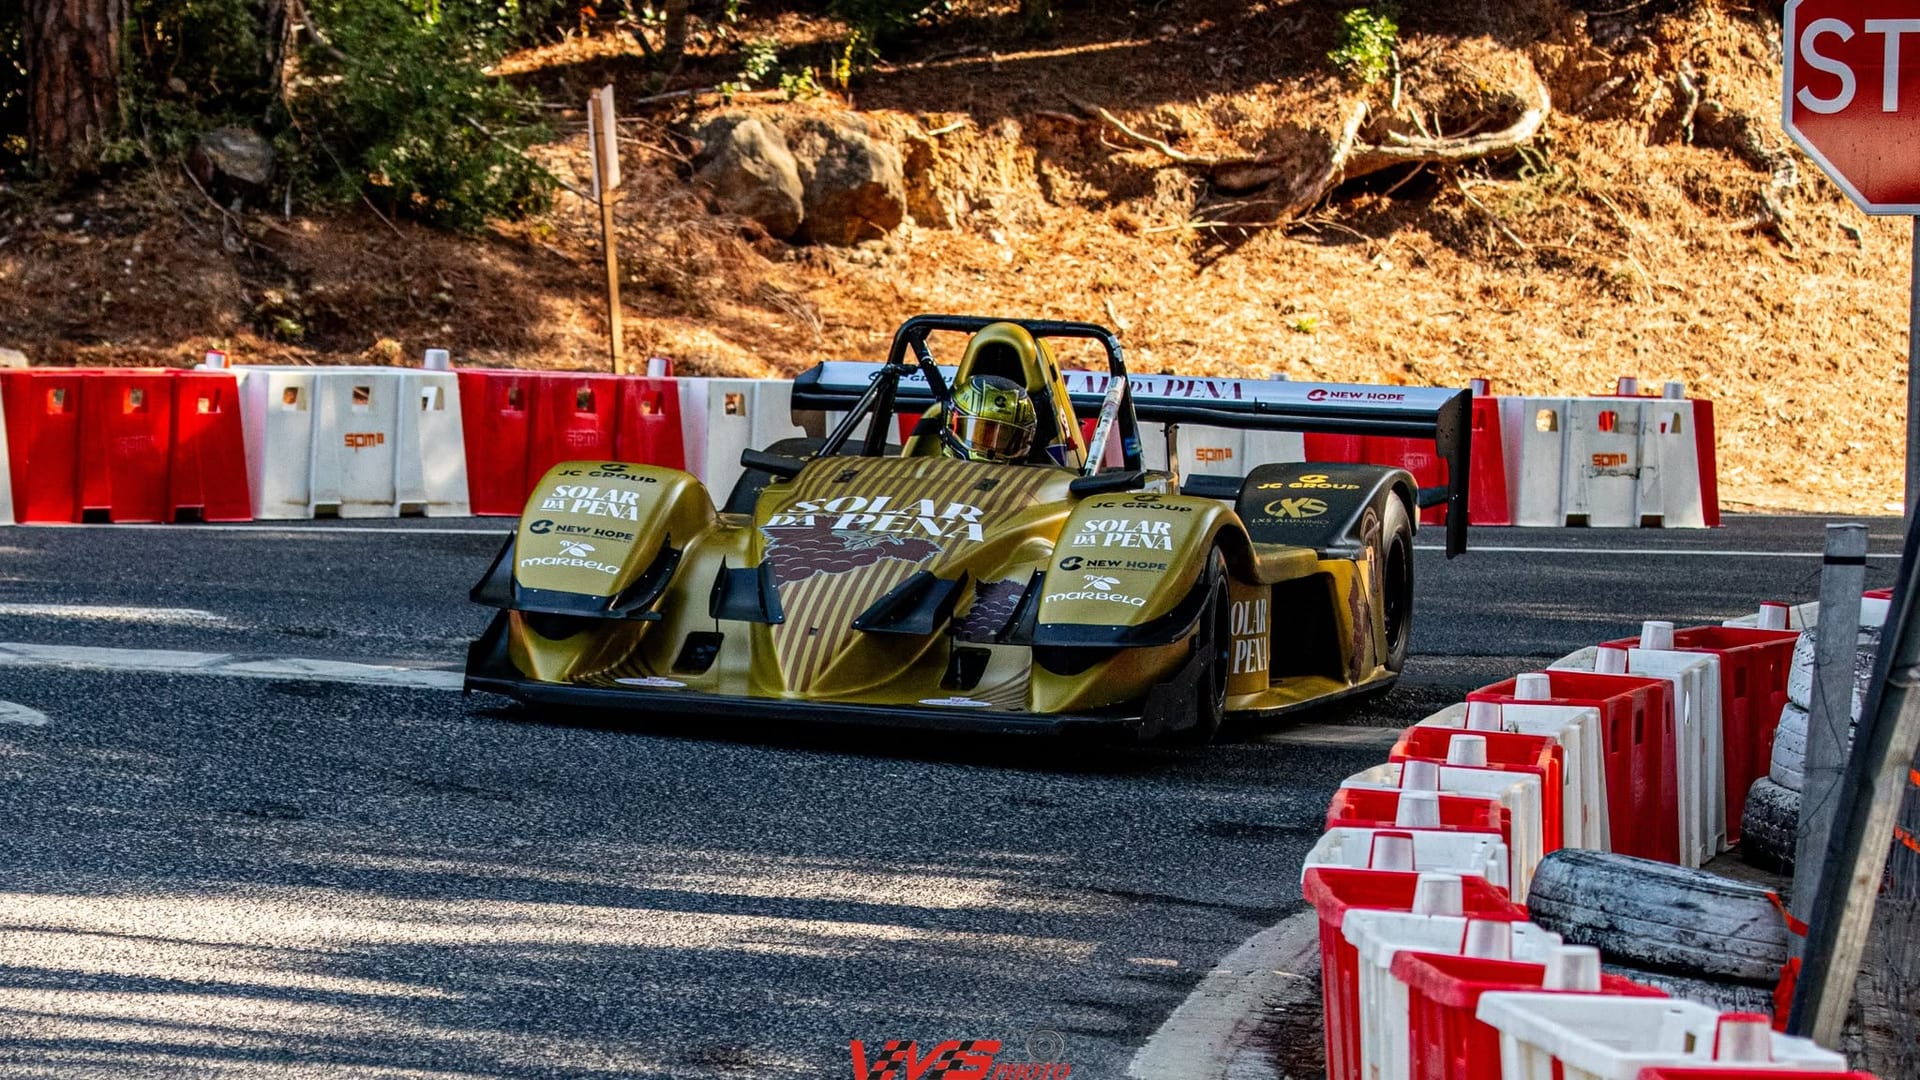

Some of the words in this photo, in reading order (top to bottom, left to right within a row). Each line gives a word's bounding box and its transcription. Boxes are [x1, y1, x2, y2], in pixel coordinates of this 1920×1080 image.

[1796, 17, 1920, 114] ST
[1163, 379, 1243, 400] PENA
[1330, 391, 1363, 399] NEW
[1367, 392, 1405, 401] HOPE
[589, 471, 657, 483] GROUP
[1257, 482, 1283, 490] JC
[1288, 482, 1361, 490] GROUP
[551, 484, 640, 506] SOLAR
[539, 498, 564, 512] DA
[570, 499, 638, 522] PENA
[787, 495, 984, 523] SOLAR
[1121, 502, 1192, 513] GROUP
[555, 524, 590, 534] NEW
[594, 529, 634, 540] HOPE
[762, 513, 816, 529] DA
[831, 513, 984, 542] PENA
[1081, 518, 1172, 536] SOLAR
[1072, 533, 1097, 548] DA
[1103, 532, 1173, 551] PENA
[1086, 559, 1123, 568] NEW
[1126, 560, 1168, 571] HOPE
[1230, 598, 1267, 637] OLAR
